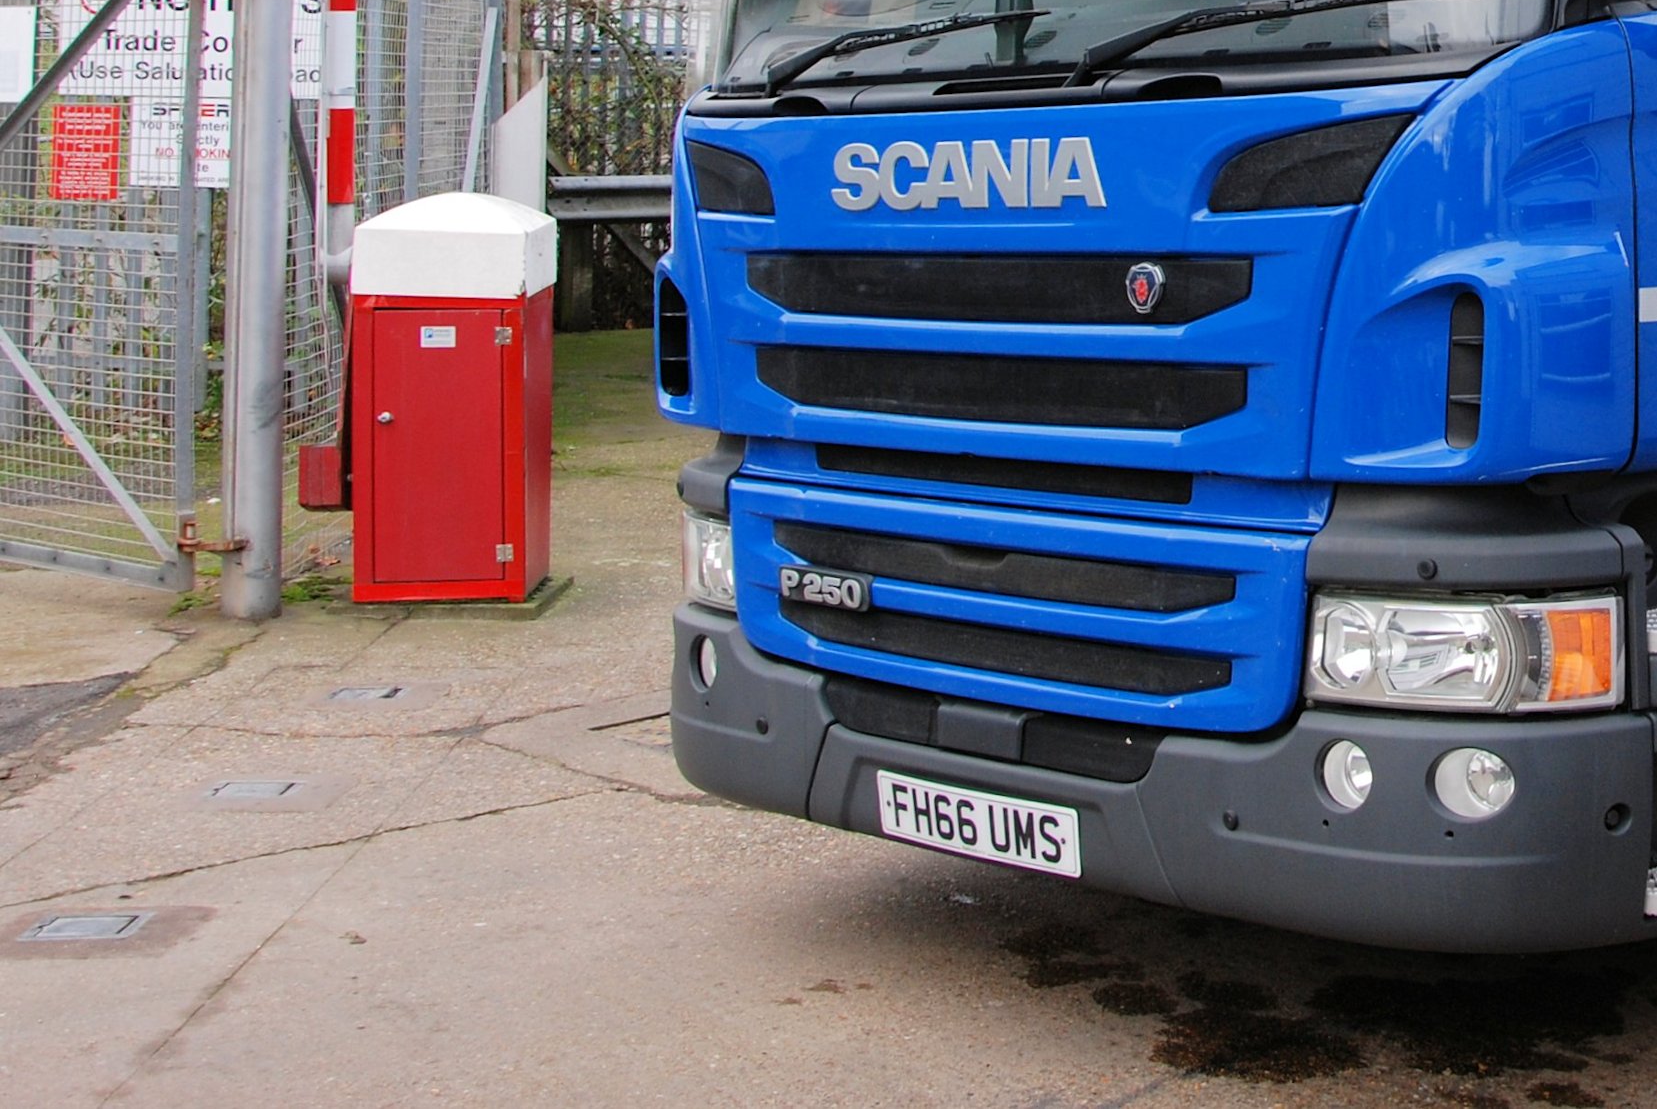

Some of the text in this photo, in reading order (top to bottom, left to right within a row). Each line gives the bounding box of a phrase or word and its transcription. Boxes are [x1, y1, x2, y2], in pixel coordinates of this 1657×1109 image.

[104, 28, 177, 53] Trade
[830, 135, 1108, 212] SCANIA
[779, 568, 862, 610] P 250
[890, 781, 1063, 865] FH66 UMS
